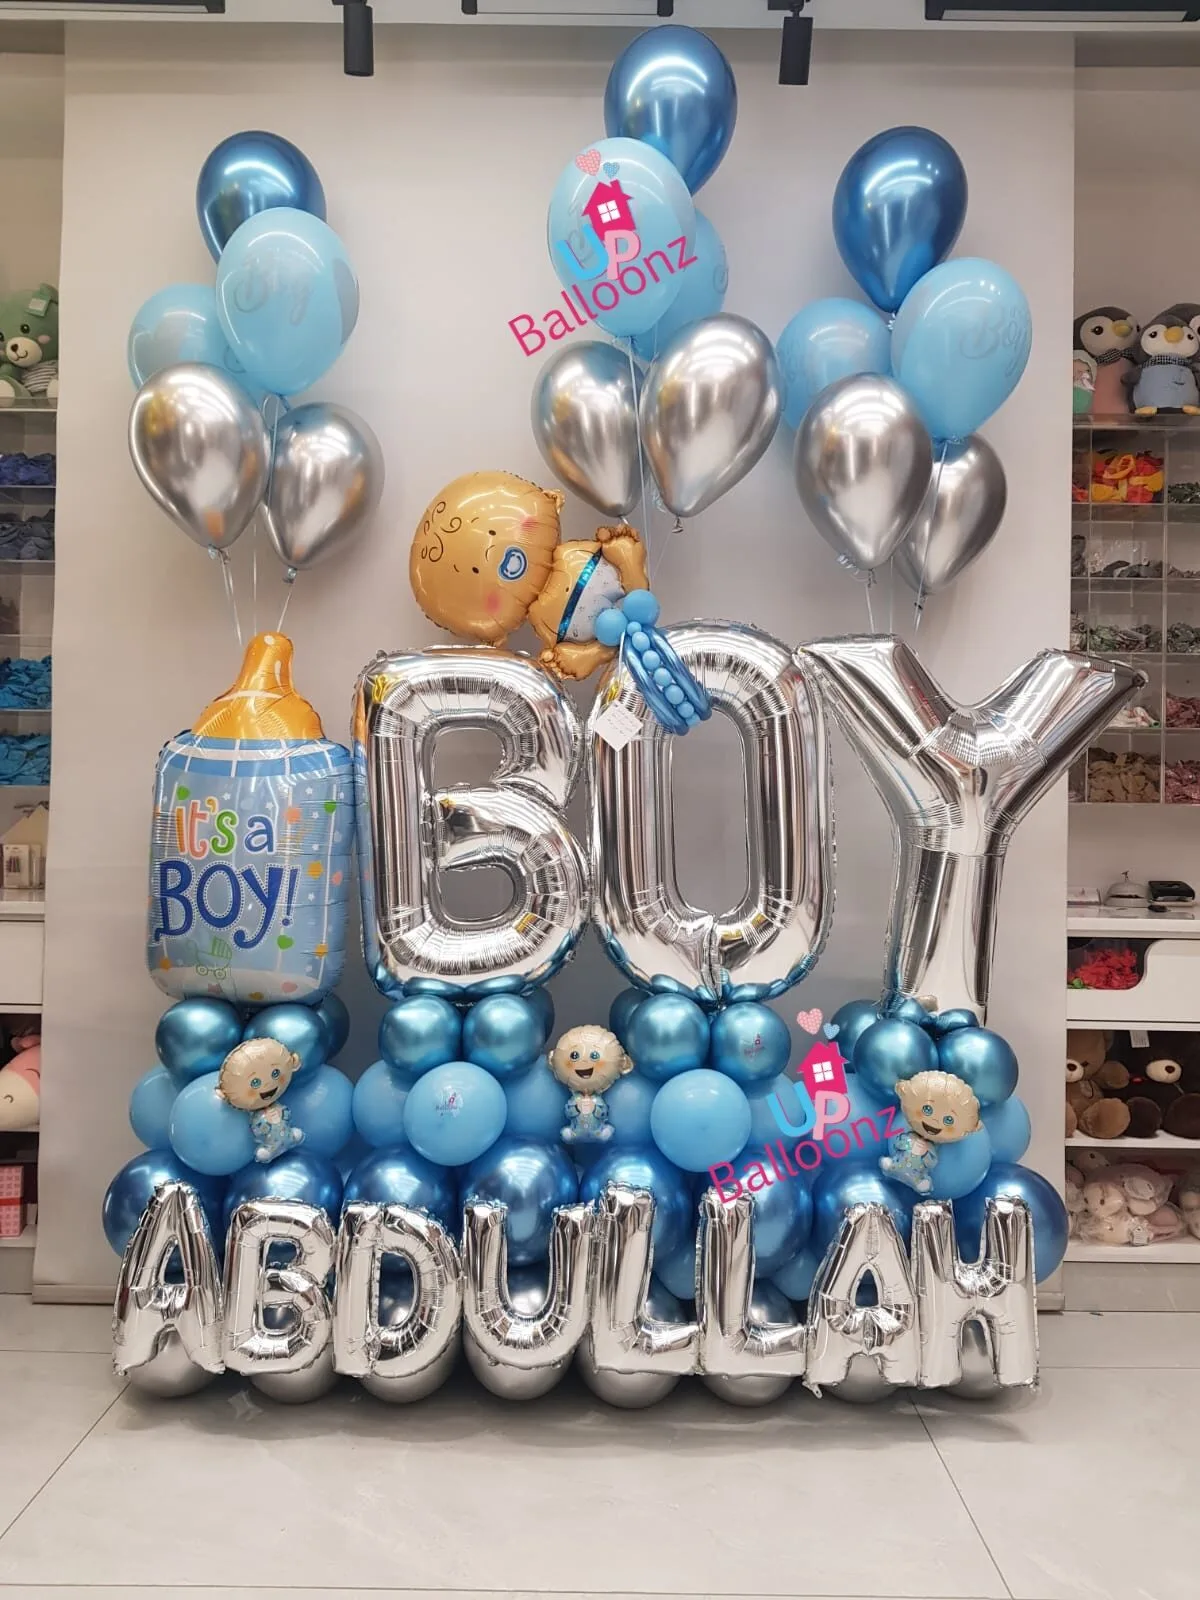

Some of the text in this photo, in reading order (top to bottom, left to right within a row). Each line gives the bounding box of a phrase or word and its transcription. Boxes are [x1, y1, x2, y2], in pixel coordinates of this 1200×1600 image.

[243, 814, 277, 855] a
[353, 619, 1148, 1024] BOY
[112, 1180, 1040, 1393] ABDULLAH
